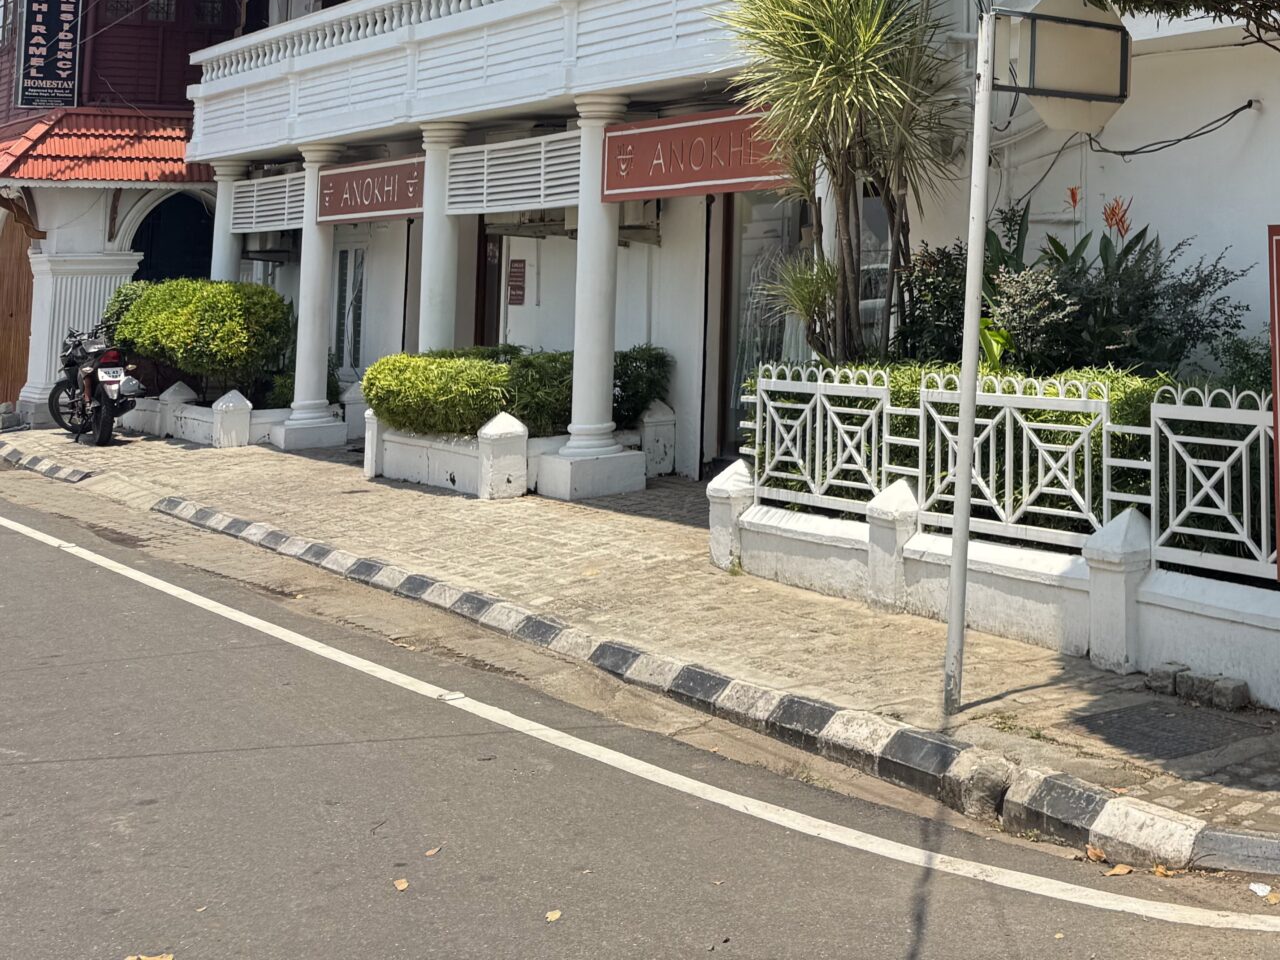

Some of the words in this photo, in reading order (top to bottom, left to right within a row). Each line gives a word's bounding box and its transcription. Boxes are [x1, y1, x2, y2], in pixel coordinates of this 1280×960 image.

[24, 79, 74, 89] HOMESTAY
[649, 131, 755, 176] ANOKHI
[341, 174, 398, 207] ANOKHI
